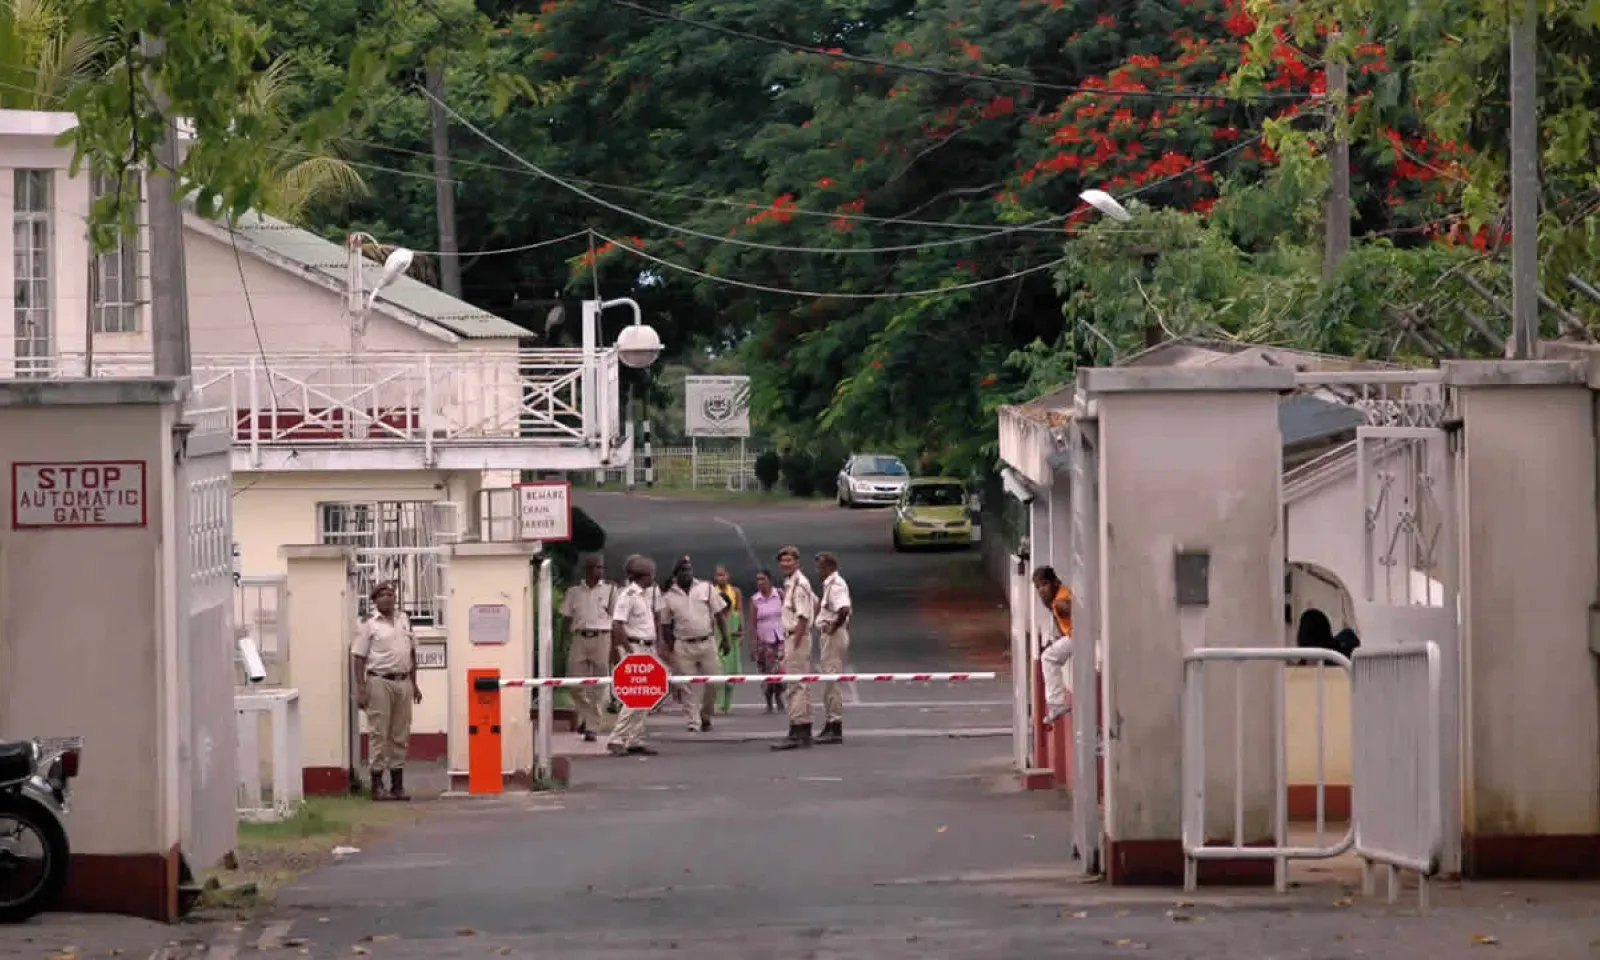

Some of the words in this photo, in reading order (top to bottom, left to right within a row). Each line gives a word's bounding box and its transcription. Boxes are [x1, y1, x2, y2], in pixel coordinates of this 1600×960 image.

[38, 467, 121, 489] STOP
[20, 490, 138, 508] AUTOMATIC
[526, 490, 565, 500] BEWARE
[53, 507, 106, 523] GATE
[624, 663, 655, 674] STOP
[630, 676, 648, 684] FOR
[614, 686, 664, 696] CONTROL
